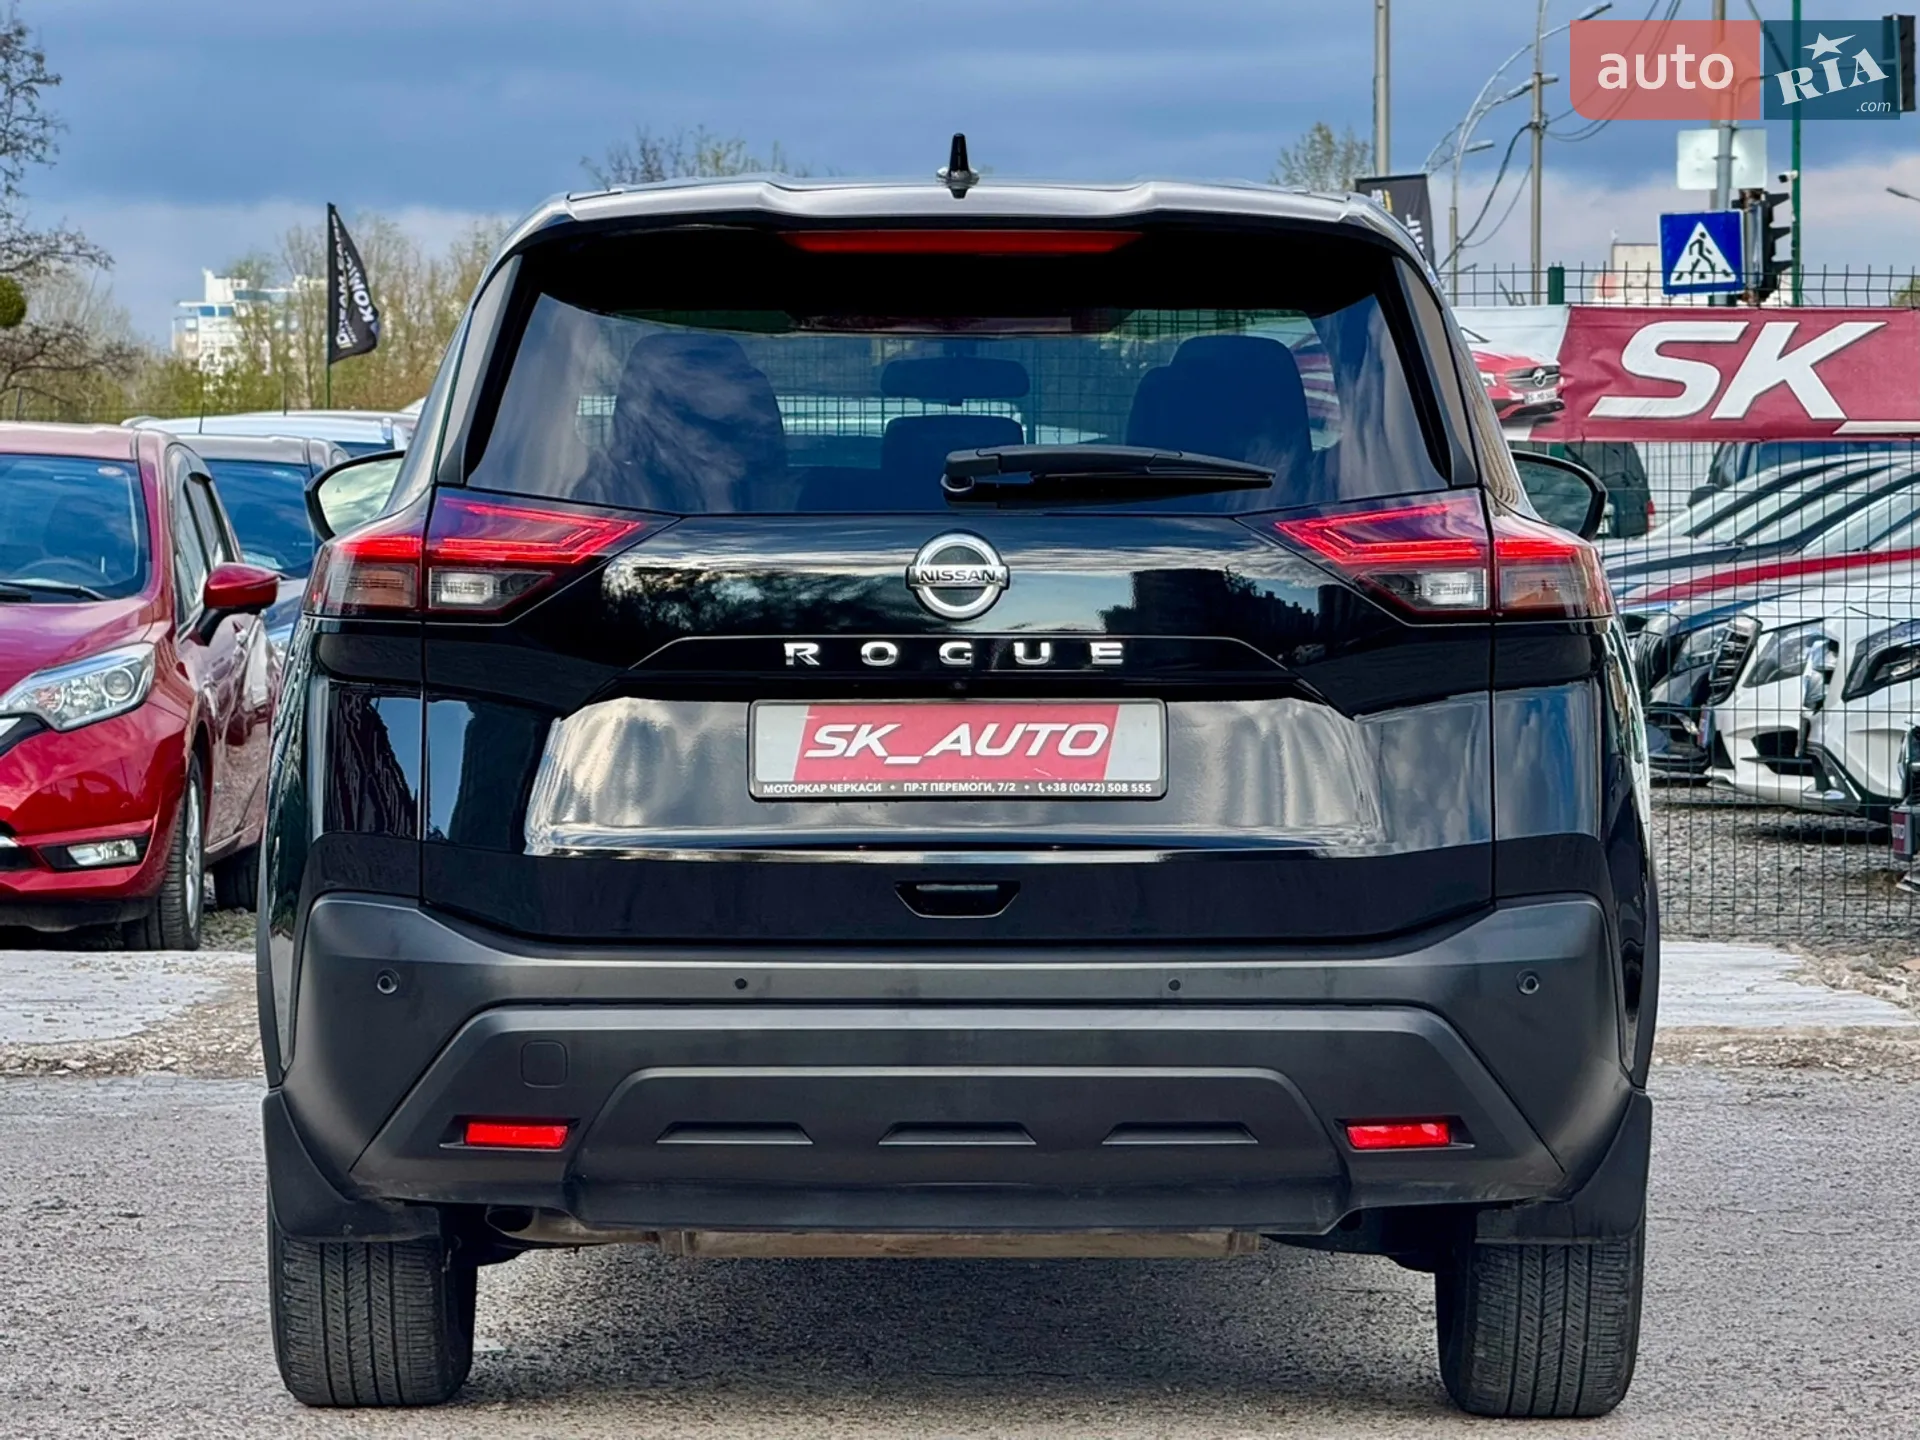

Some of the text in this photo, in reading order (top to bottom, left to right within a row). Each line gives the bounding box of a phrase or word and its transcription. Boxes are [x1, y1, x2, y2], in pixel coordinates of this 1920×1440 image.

[919, 569, 996, 583] NISSAN
[783, 641, 1124, 666] ROGUE
[804, 722, 1109, 764] SK_AUTO
[763, 783, 827, 793] МОТОРКАР
[829, 783, 882, 793] ЧЕРКАСИ
[903, 783, 928, 792] ПР-Т
[930, 783, 996, 793] ПЕРЕМОГИ,
[998, 782, 1016, 792] 7/2
[1069, 783, 1105, 794] (0472)
[1107, 783, 1128, 793] 508
[1131, 783, 1152, 793] 555
